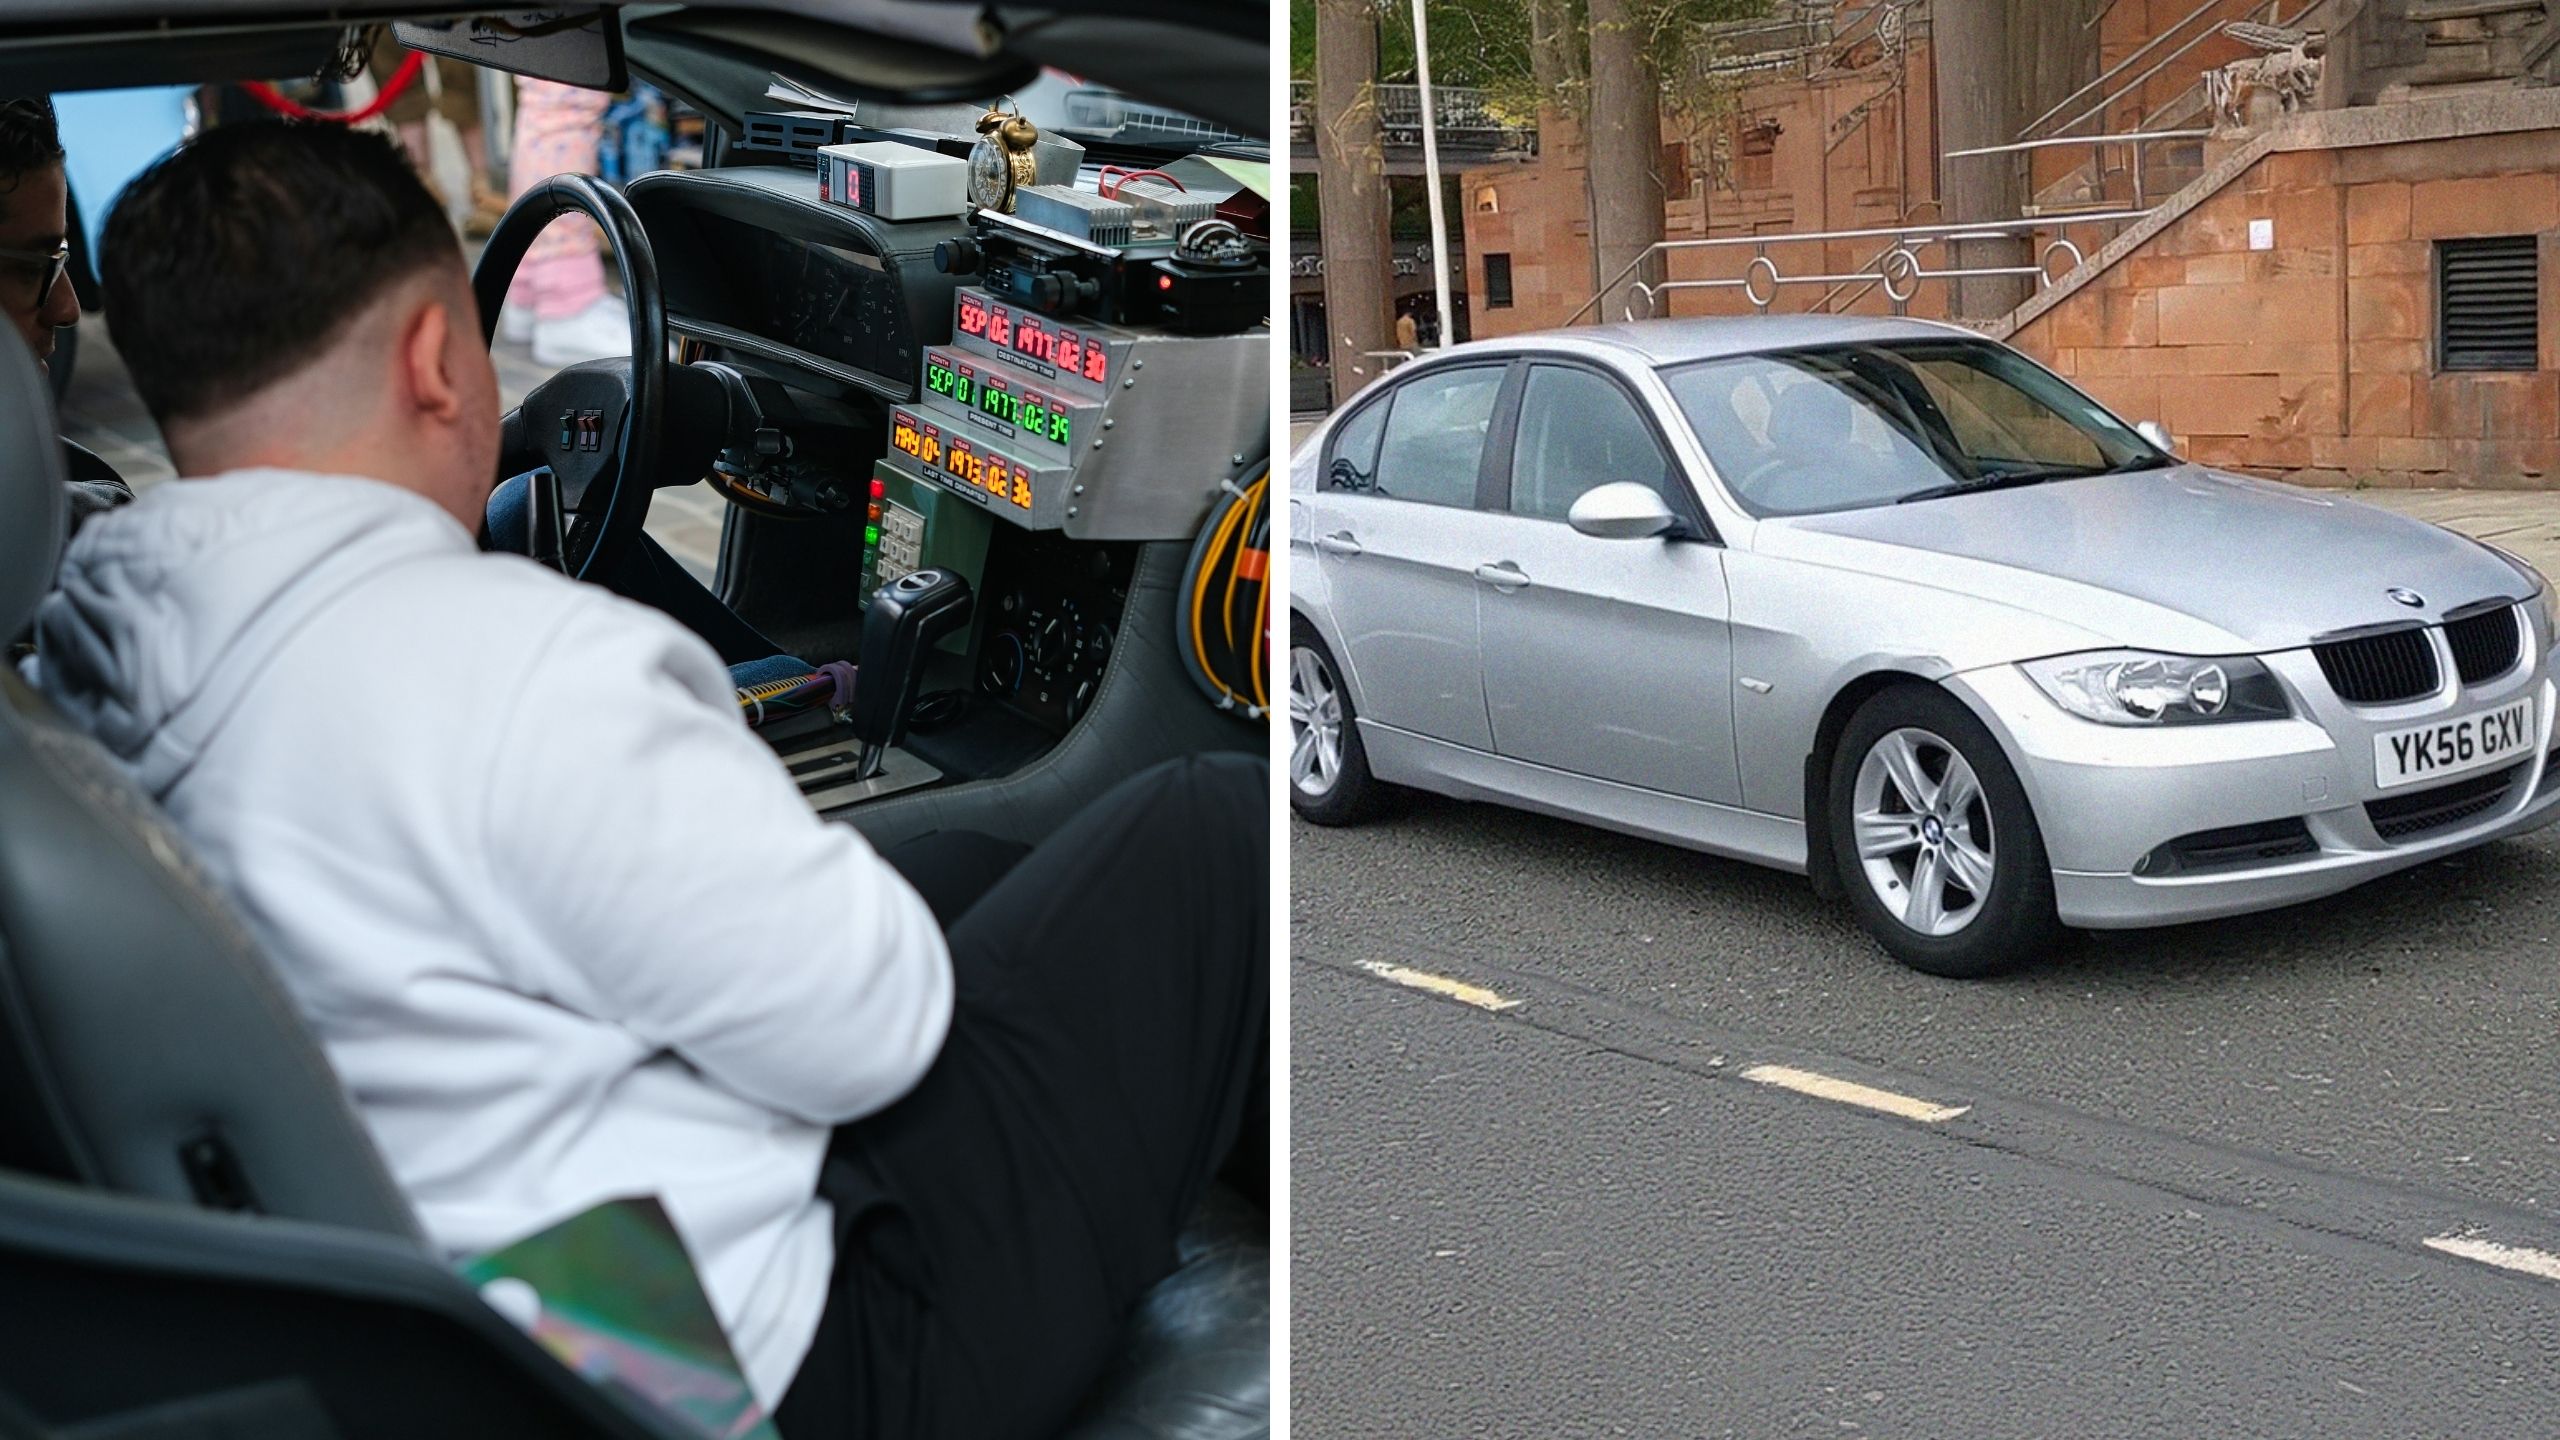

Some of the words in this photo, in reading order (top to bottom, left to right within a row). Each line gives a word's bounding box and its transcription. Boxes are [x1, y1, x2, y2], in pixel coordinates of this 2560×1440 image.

[962, 295, 982, 307] MONTH
[993, 307, 1006, 316] DAY
[1025, 317, 1040, 327] YEAR
[960, 304, 988, 333] SEP
[990, 316, 1009, 345] 02
[1018, 326, 1054, 360] 1977
[1058, 341, 1080, 373] 02
[1084, 350, 1106, 382] 30
[930, 354, 950, 367] MONTH
[960, 367, 973, 376] DAY
[991, 378, 1006, 389] YEAR
[998, 350, 1039, 372] DESTINATION
[1040, 366, 1055, 378] TIME
[929, 365, 954, 393] SEP
[985, 388, 1018, 424] 1977
[1025, 403, 1044, 434] 02
[1049, 413, 1070, 443] 39
[896, 412, 916, 426] MONTH
[925, 426, 938, 435] DAY
[955, 438, 970, 451] YEAR
[969, 412, 997, 431] PRESENT
[998, 424, 1013, 437] TIME
[894, 424, 921, 456] MAY
[950, 449, 982, 486] 1973
[988, 465, 1008, 498] 02
[923, 466, 939, 479] LAST
[939, 474, 954, 487] TIME
[954, 481, 987, 503] DEPARTED
[2391, 721, 2474, 775] YK56
[2481, 705, 2524, 754] GXV
